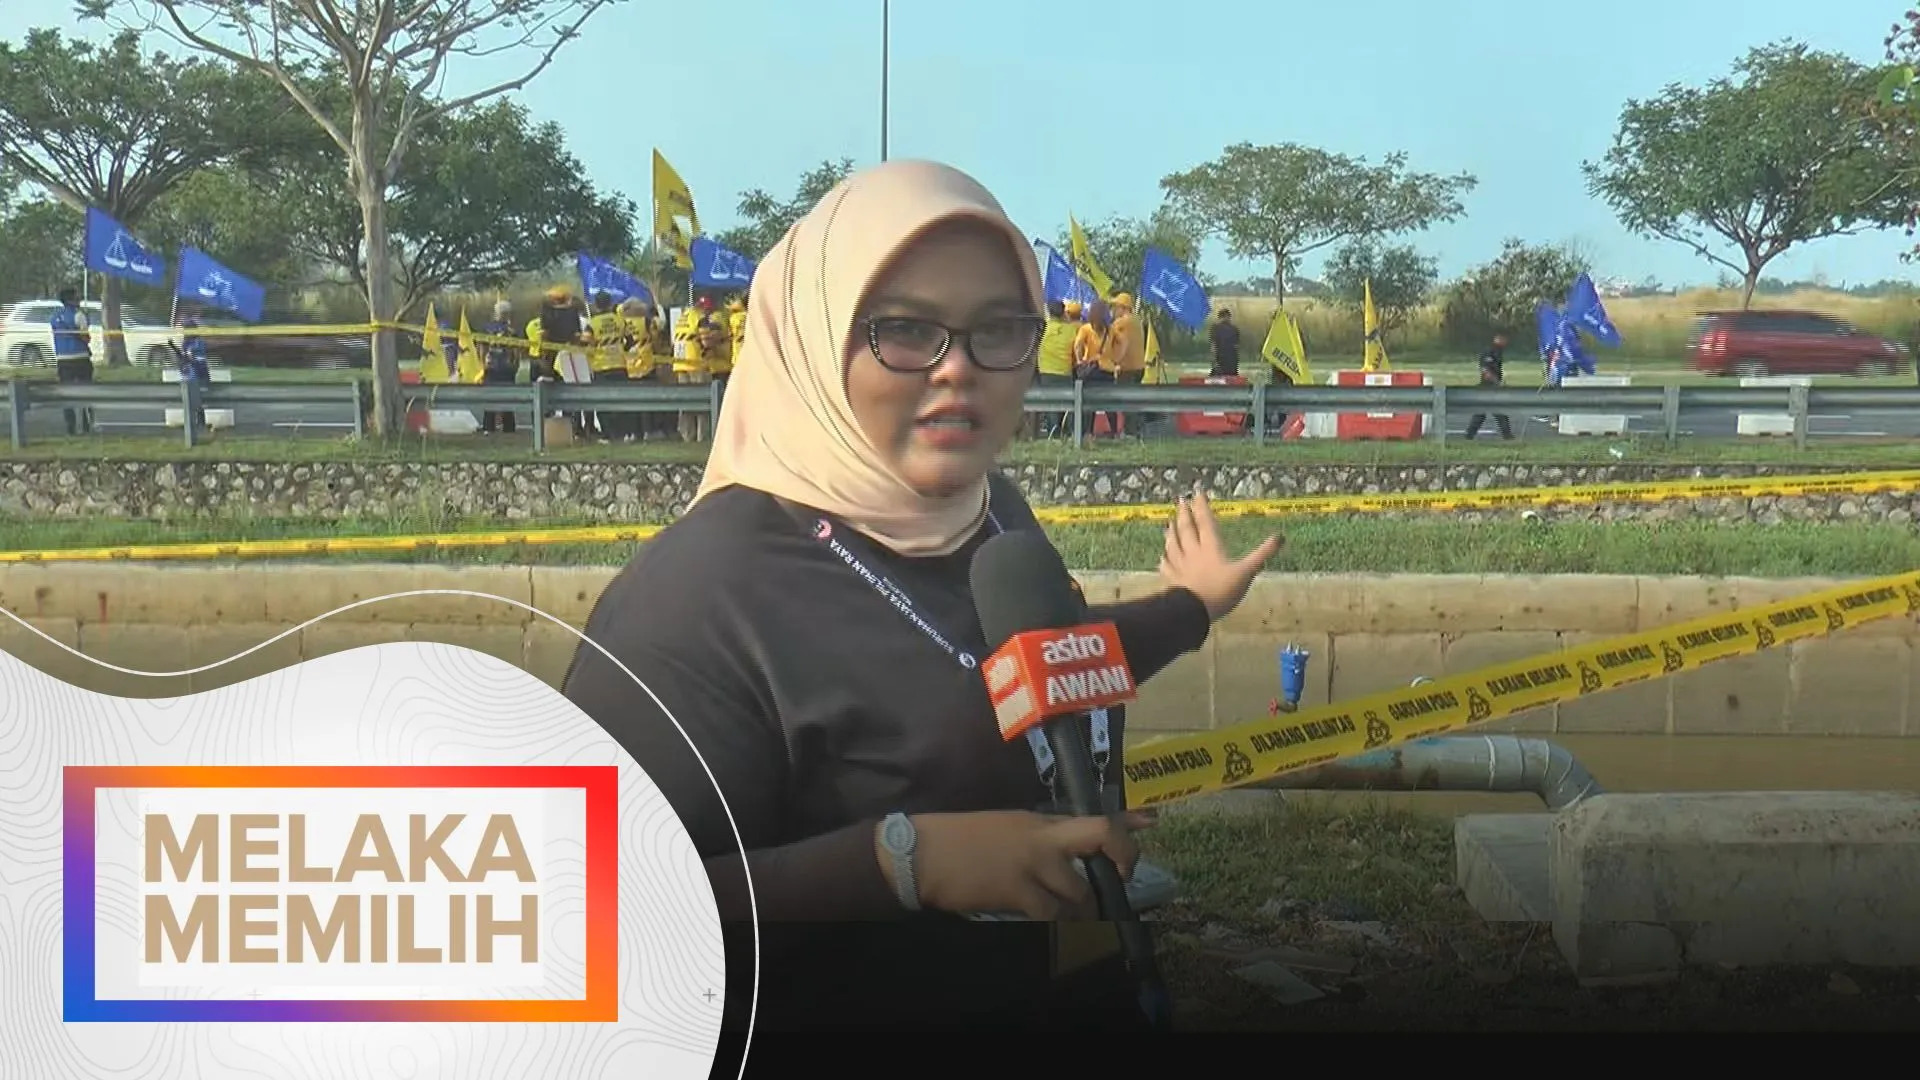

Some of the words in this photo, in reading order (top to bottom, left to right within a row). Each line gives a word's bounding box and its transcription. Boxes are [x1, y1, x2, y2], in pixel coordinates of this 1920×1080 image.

[828, 538, 855, 564] RAYA
[1040, 633, 1106, 664] astro
[1046, 664, 1131, 706] AWANI
